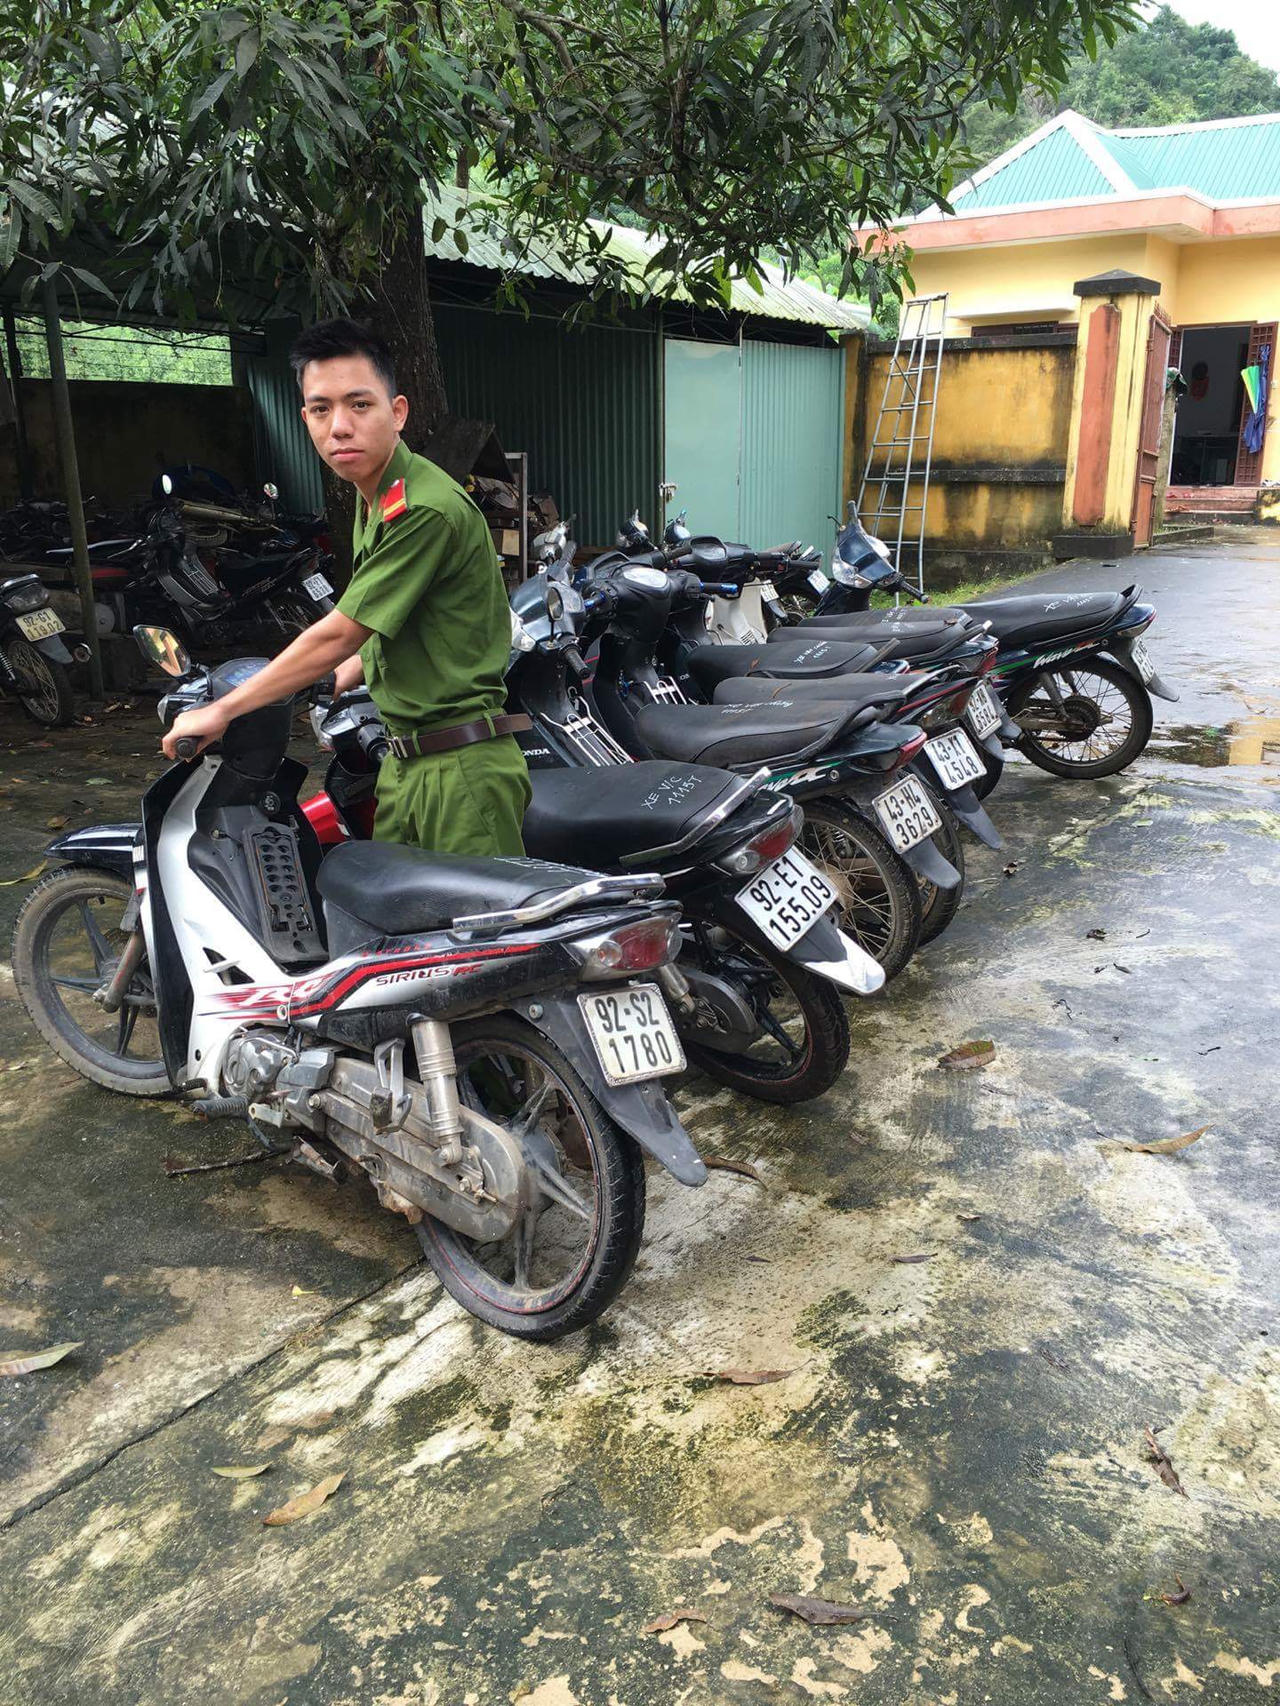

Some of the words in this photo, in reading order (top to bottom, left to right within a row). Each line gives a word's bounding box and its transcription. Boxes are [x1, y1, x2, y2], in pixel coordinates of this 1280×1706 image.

[520, 748, 550, 757] ONDA
[931, 735, 966, 763] 43-X1
[944, 755, 979, 784] 4548
[641, 792, 659, 810] XE
[884, 784, 921, 820] 43-H4
[896, 806, 934, 845] 3629
[750, 856, 803, 911] 92-E1
[769, 875, 831, 941] 155.09
[376, 966, 450, 986] SIRIUS
[594, 991, 660, 1033] 92-S2
[608, 1030, 682, 1074] 1780
